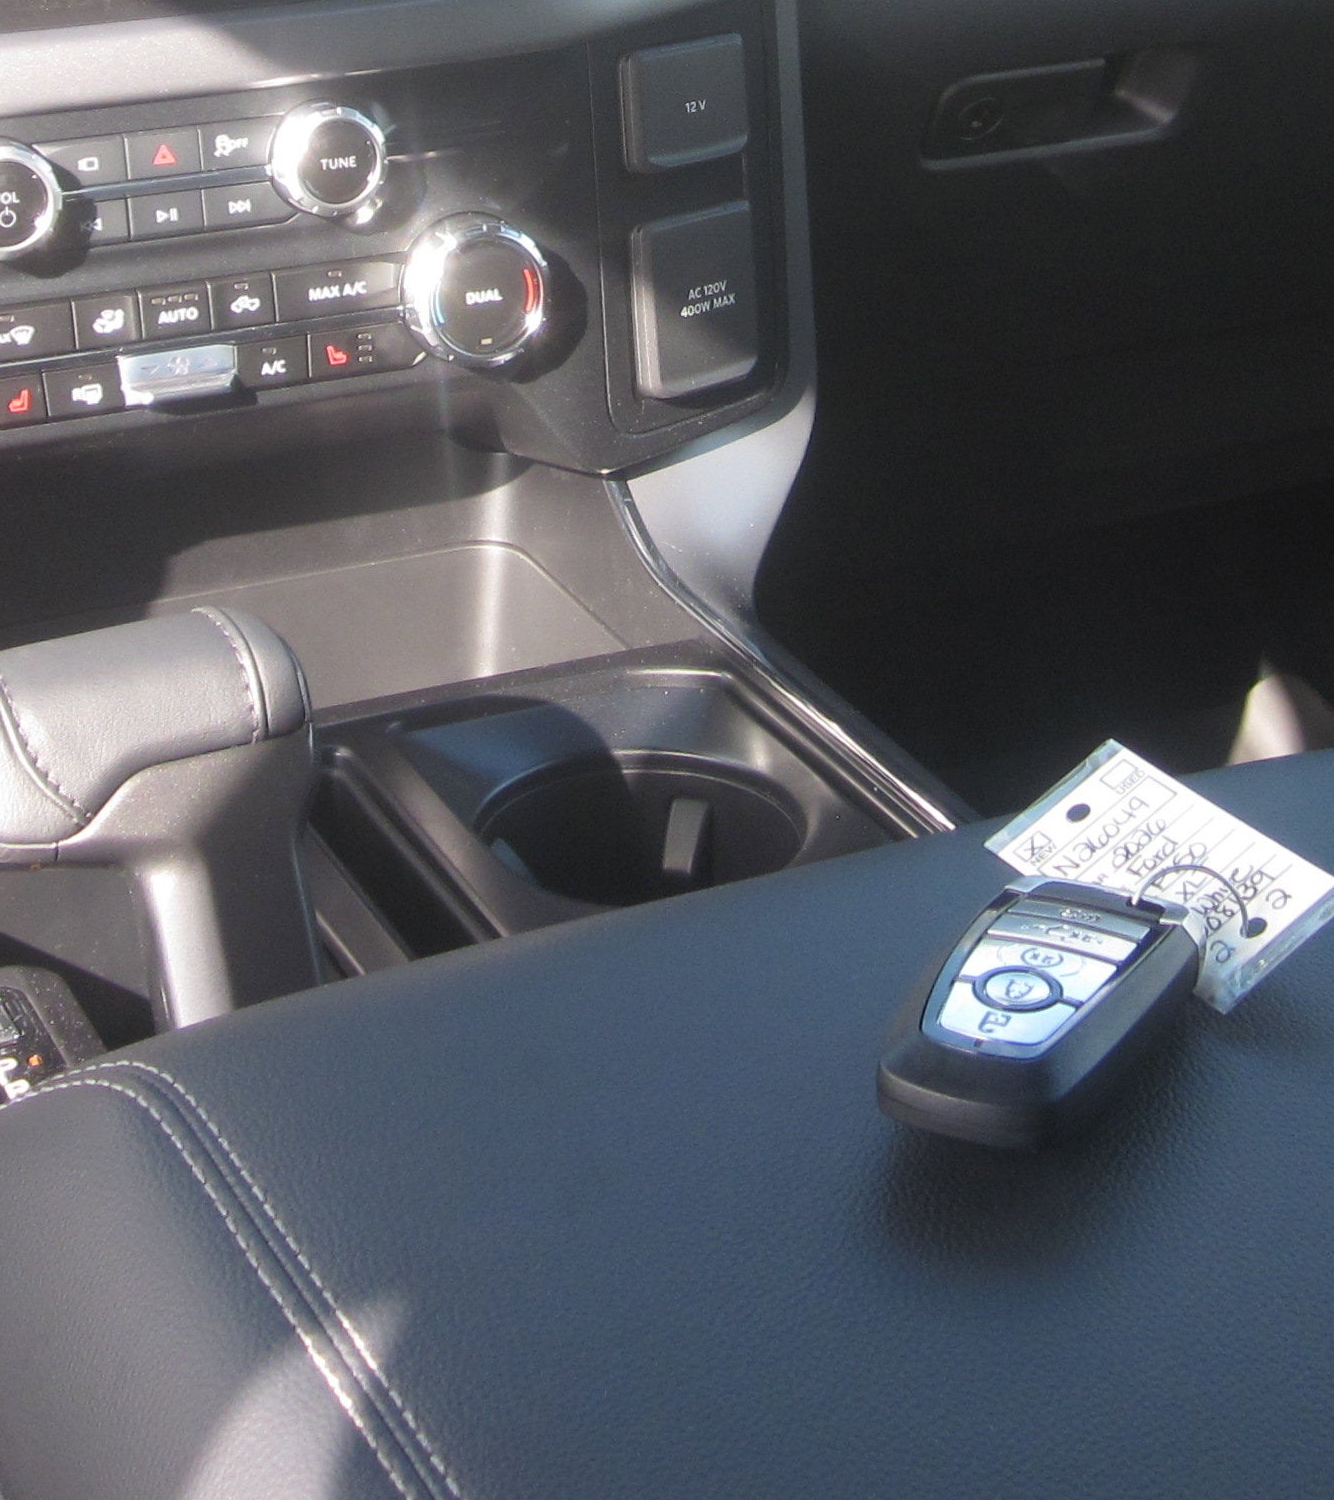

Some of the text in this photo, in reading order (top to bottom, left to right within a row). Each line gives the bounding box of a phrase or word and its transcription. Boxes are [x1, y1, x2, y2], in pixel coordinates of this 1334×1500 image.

[685, 99, 707, 113] 12 V
[320, 155, 357, 170] TUNE
[308, 281, 367, 302] MAX A/C
[466, 289, 503, 305] DUAL
[688, 280, 727, 301] AC 120V
[157, 307, 199, 325] AUTO
[680, 293, 736, 318] 400W MAX
[261, 359, 286, 376] A/C
[1030, 843, 1059, 867] NEW
[1126, 836, 1179, 883] Ford
[1190, 866, 1256, 917] Whie
